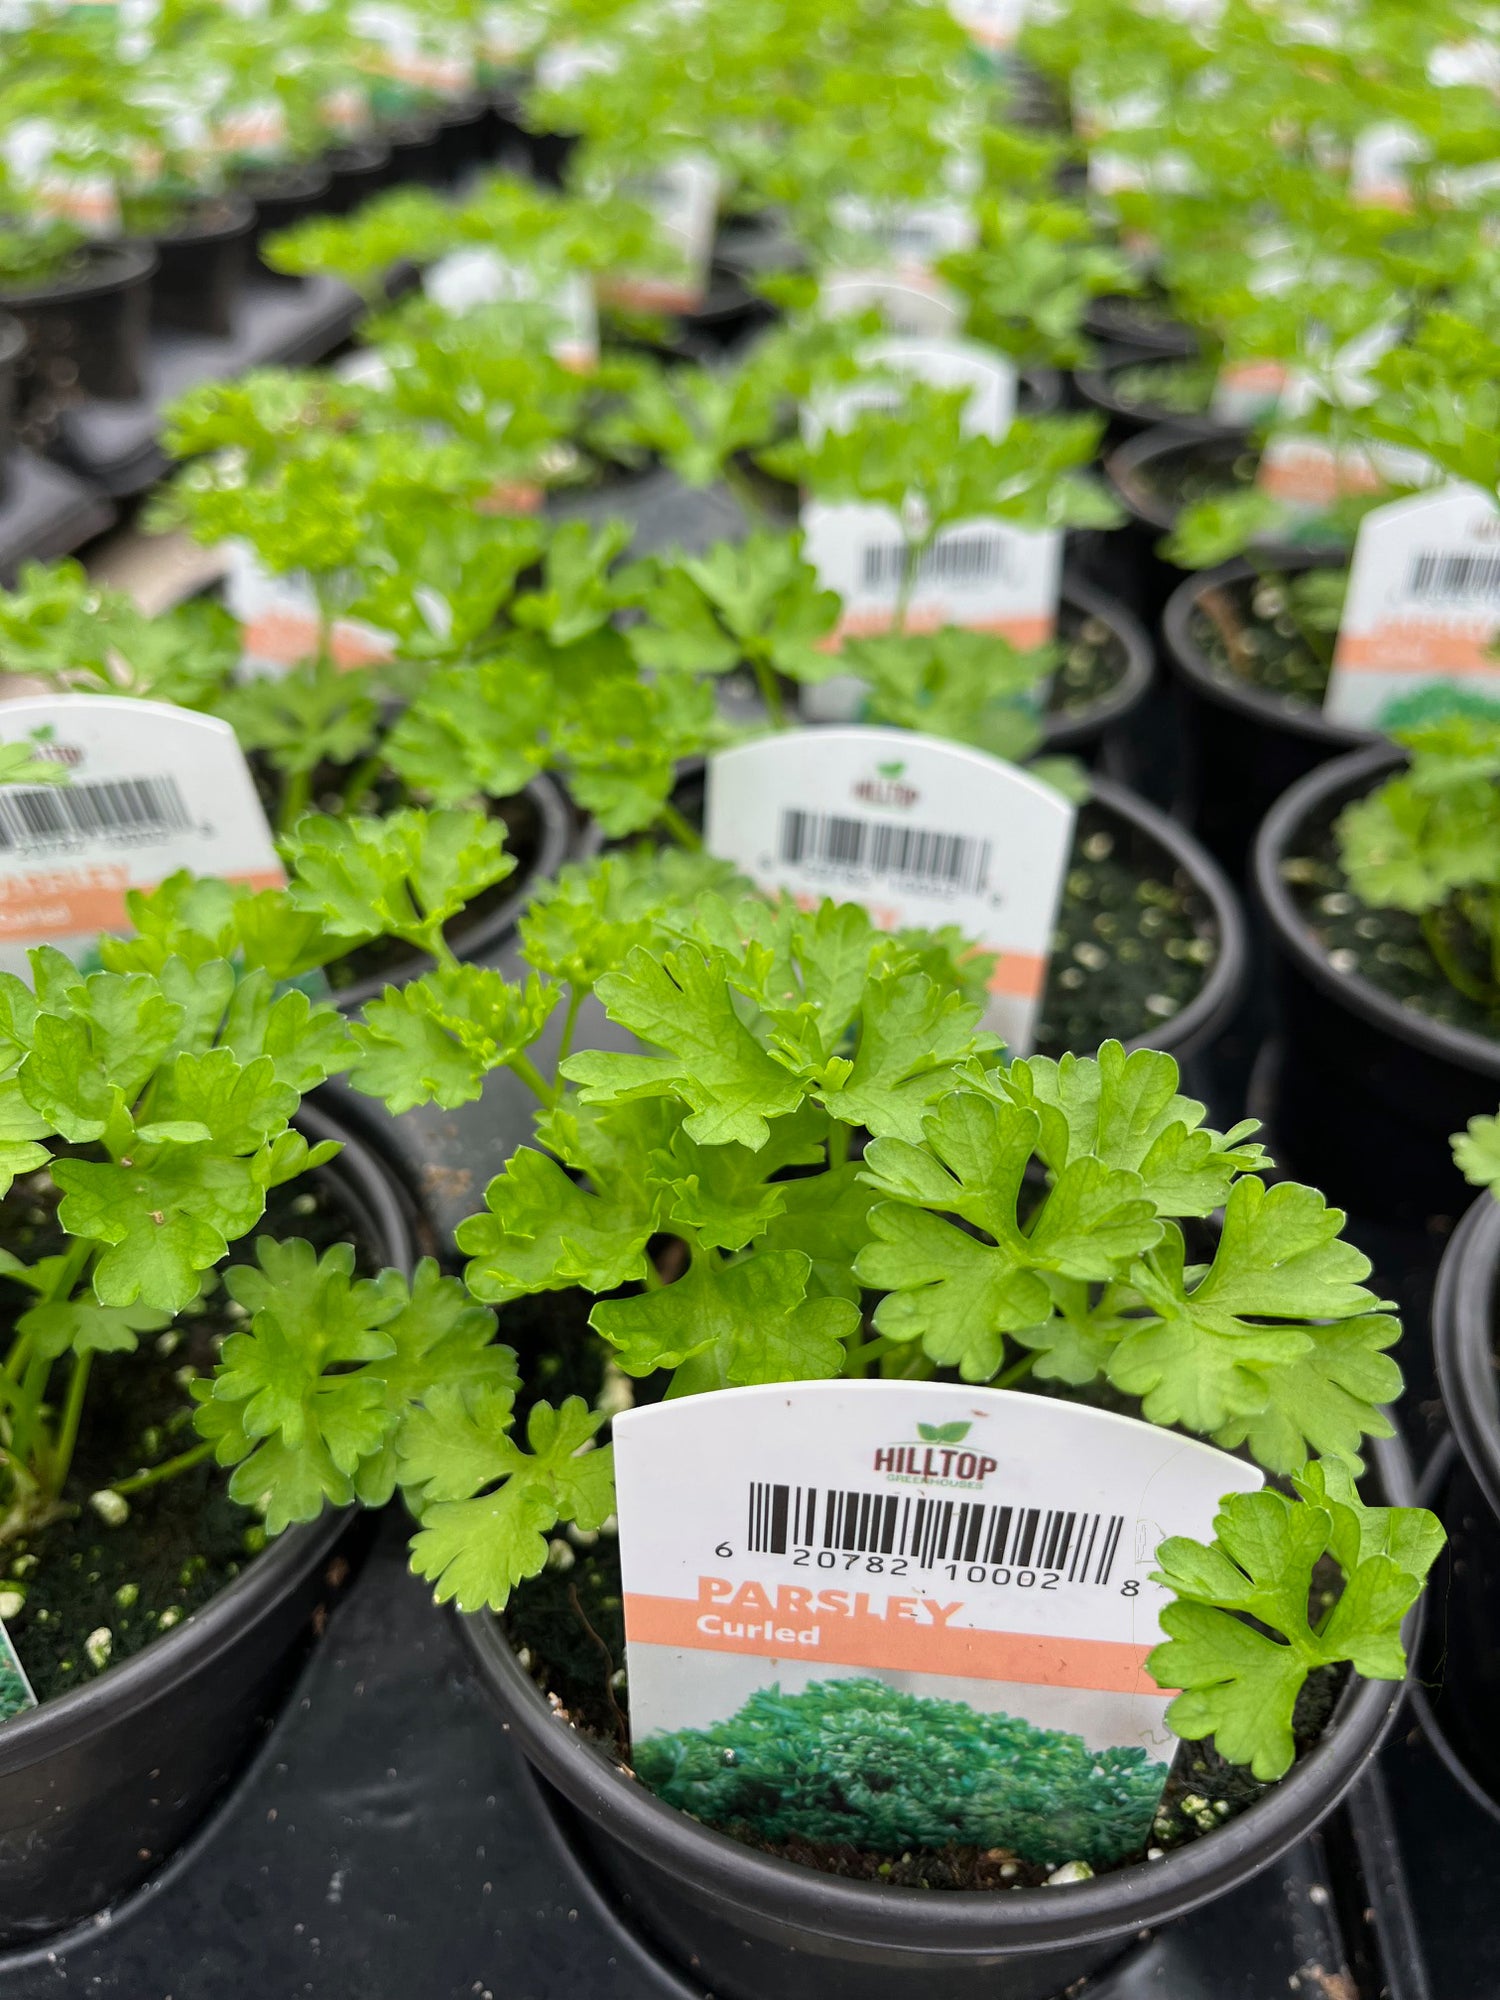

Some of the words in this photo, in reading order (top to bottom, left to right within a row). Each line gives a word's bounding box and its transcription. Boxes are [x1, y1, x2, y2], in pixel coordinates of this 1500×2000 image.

[874, 1446, 998, 1481] HILLTOP
[886, 1473, 985, 1491] GREENHOUSES
[714, 1541, 734, 1559] 6
[792, 1549, 909, 1576] 20782
[944, 1563, 1061, 1590] 10002
[1120, 1579, 1141, 1597] 8
[697, 1575, 965, 1627] PARSLEY
[695, 1614, 821, 1646] Curled
